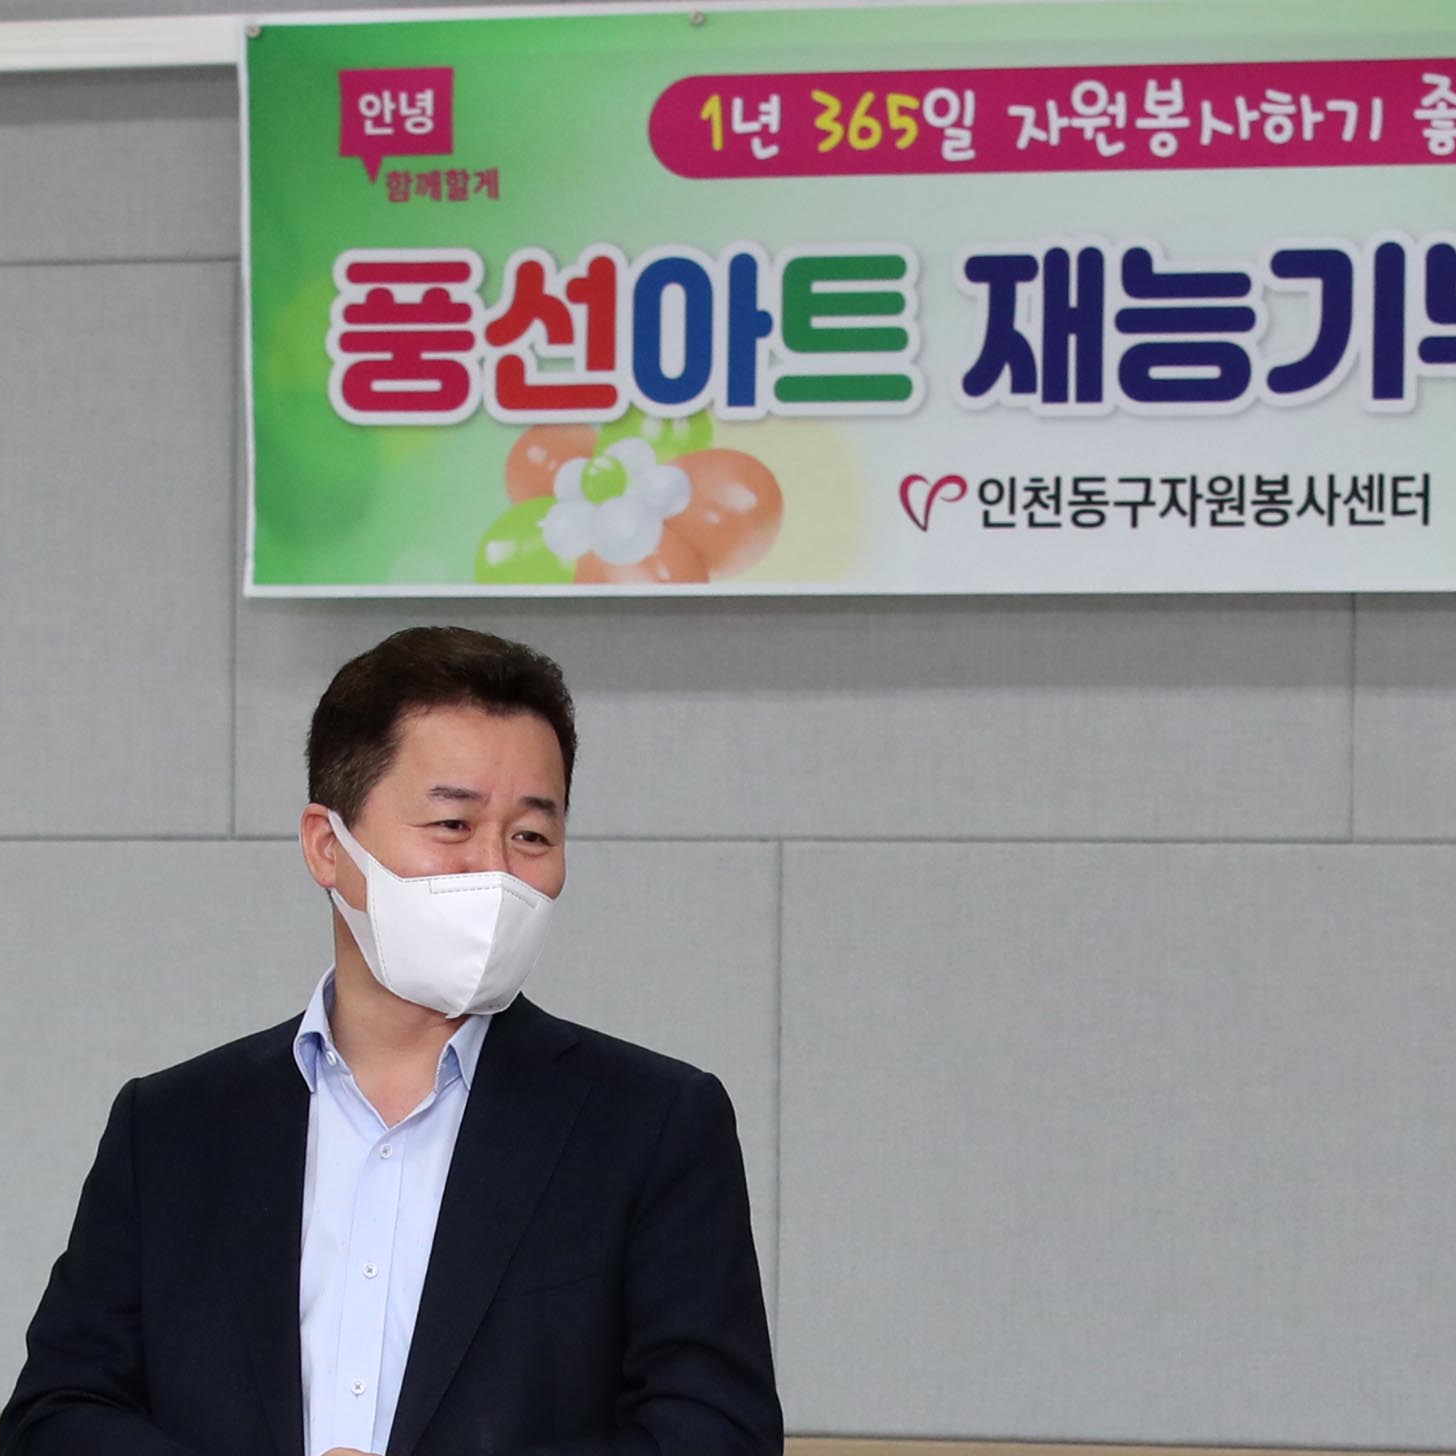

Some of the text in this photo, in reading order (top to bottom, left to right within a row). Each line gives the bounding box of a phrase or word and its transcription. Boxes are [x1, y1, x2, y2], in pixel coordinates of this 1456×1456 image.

[357, 88, 435, 136] 안녕
[699, 94, 781, 159] 1년
[811, 87, 978, 162] 365일
[1007, 78, 1384, 158] 자원봉사하기
[385, 165, 500, 203] 함께할게
[338, 252, 914, 412] 풍선아트
[977, 472, 1432, 530] 인천동구자원봉사센터
